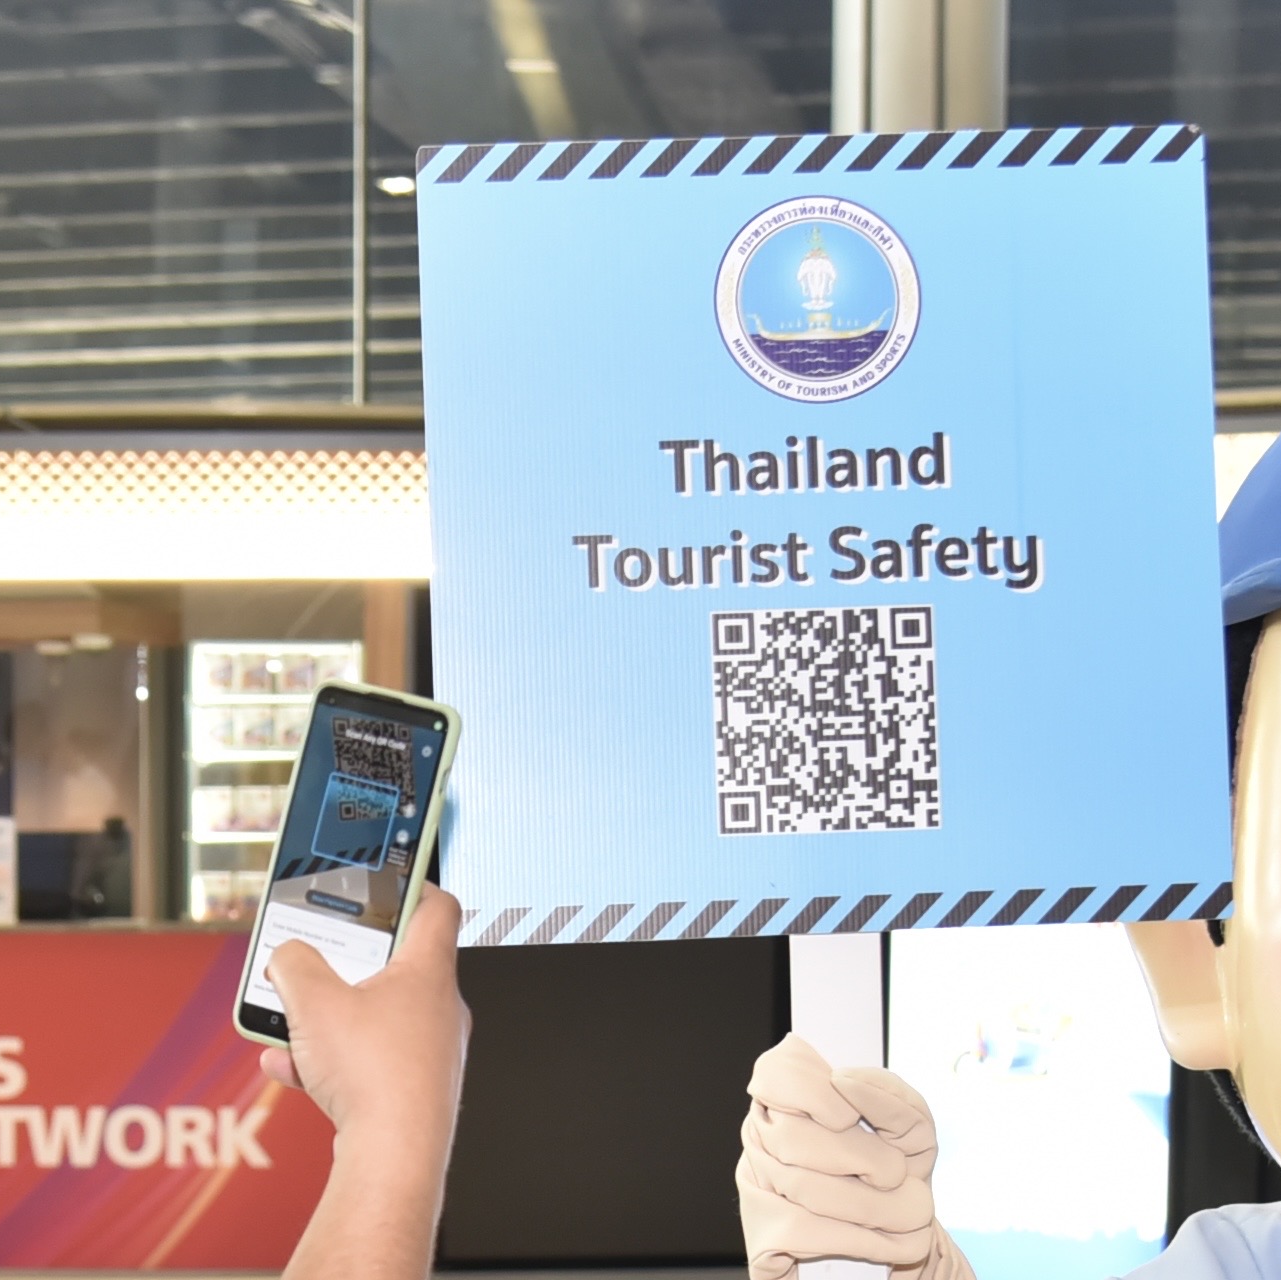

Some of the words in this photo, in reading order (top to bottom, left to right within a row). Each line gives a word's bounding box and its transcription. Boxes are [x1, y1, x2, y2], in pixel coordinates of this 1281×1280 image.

[732, 337, 776, 383] MINISTRY
[777, 379, 792, 391] OF
[796, 383, 849, 397] TOURISM
[852, 371, 876, 390] AND
[875, 333, 907, 374] SPORTS
[659, 432, 950, 496] Thailand
[572, 530, 812, 591] Tourist
[828, 523, 1043, 592] Safety
